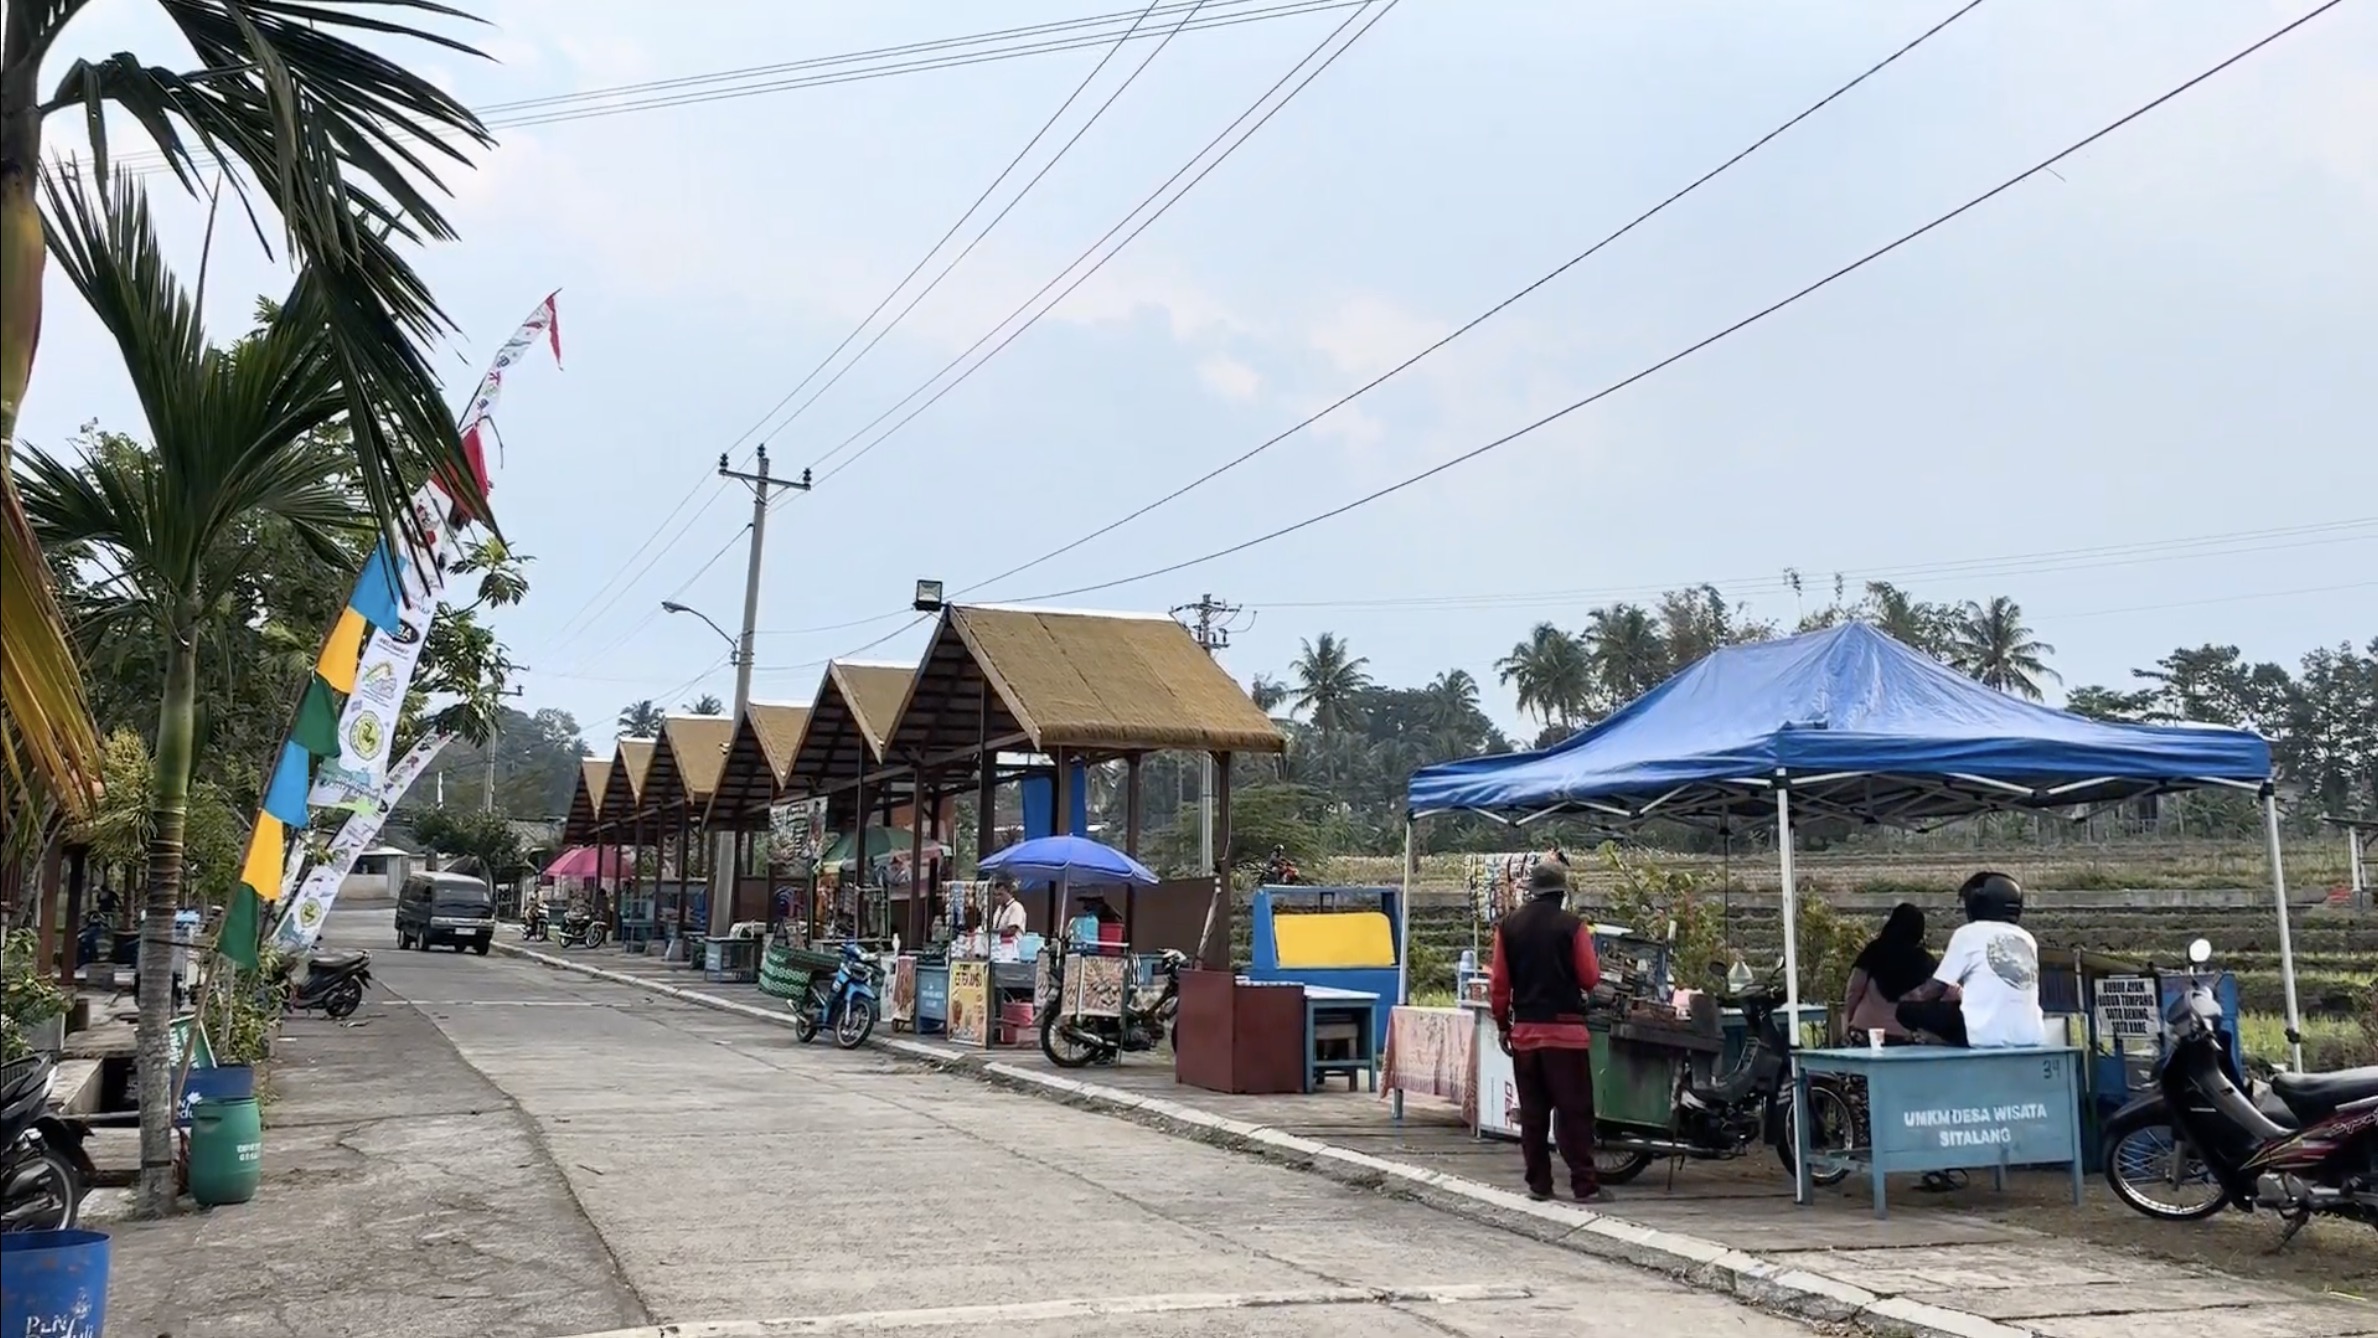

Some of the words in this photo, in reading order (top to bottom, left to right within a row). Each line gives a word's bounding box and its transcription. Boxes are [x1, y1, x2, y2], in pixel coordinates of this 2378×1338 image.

[1903, 1110, 1951, 1127] UMKM
[1952, 1107, 1991, 1125] DESA
[1992, 1103, 2048, 1122] WISATA
[1938, 1127, 2012, 1148] SITALANG
[26, 1314, 68, 1335] PLN
